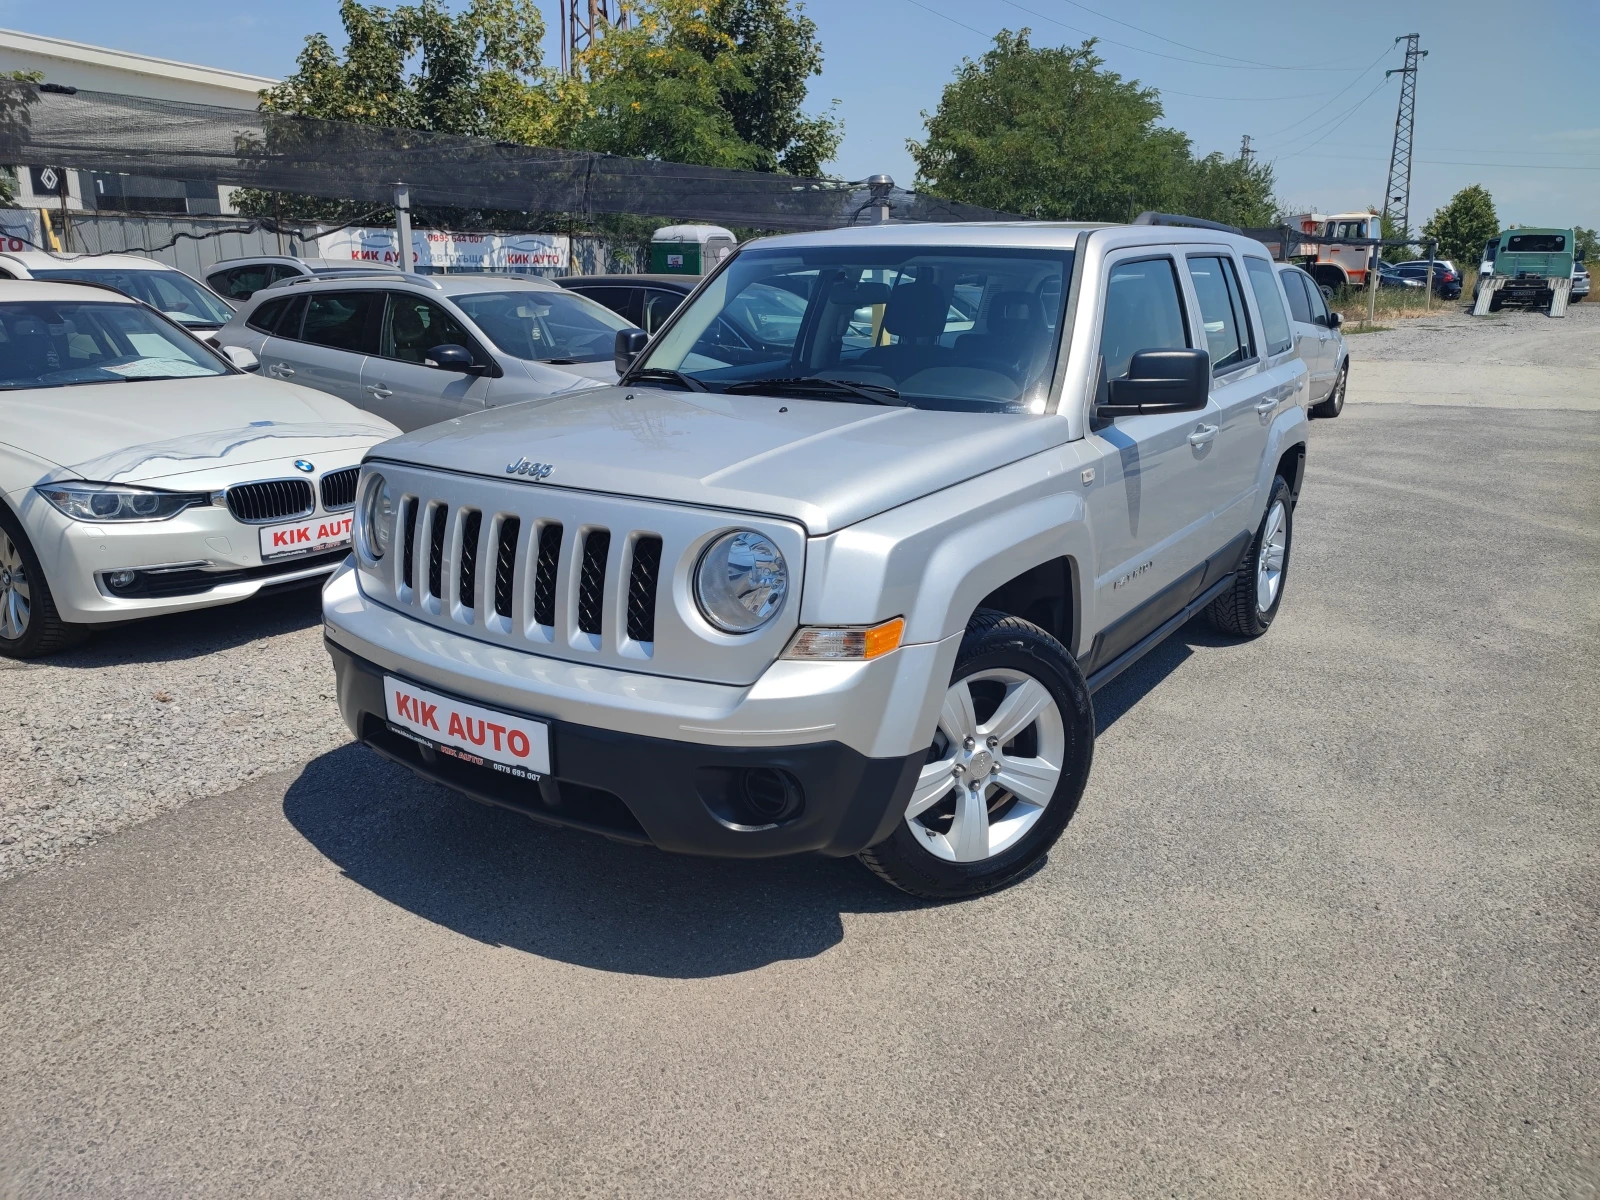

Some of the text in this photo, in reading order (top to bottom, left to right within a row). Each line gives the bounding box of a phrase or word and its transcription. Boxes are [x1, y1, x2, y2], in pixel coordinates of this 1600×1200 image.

[427, 233, 449, 242] 0895
[351, 250, 419, 263] КИК АУО
[507, 254, 560, 265] КИК АУТО
[506, 456, 556, 481] Jeep
[273, 527, 311, 547] KIK
[316, 518, 352, 539] AUT
[395, 691, 531, 758] KIK AUTO
[440, 745, 484, 766] KIK AUTO
[527, 772, 541, 782] 007
